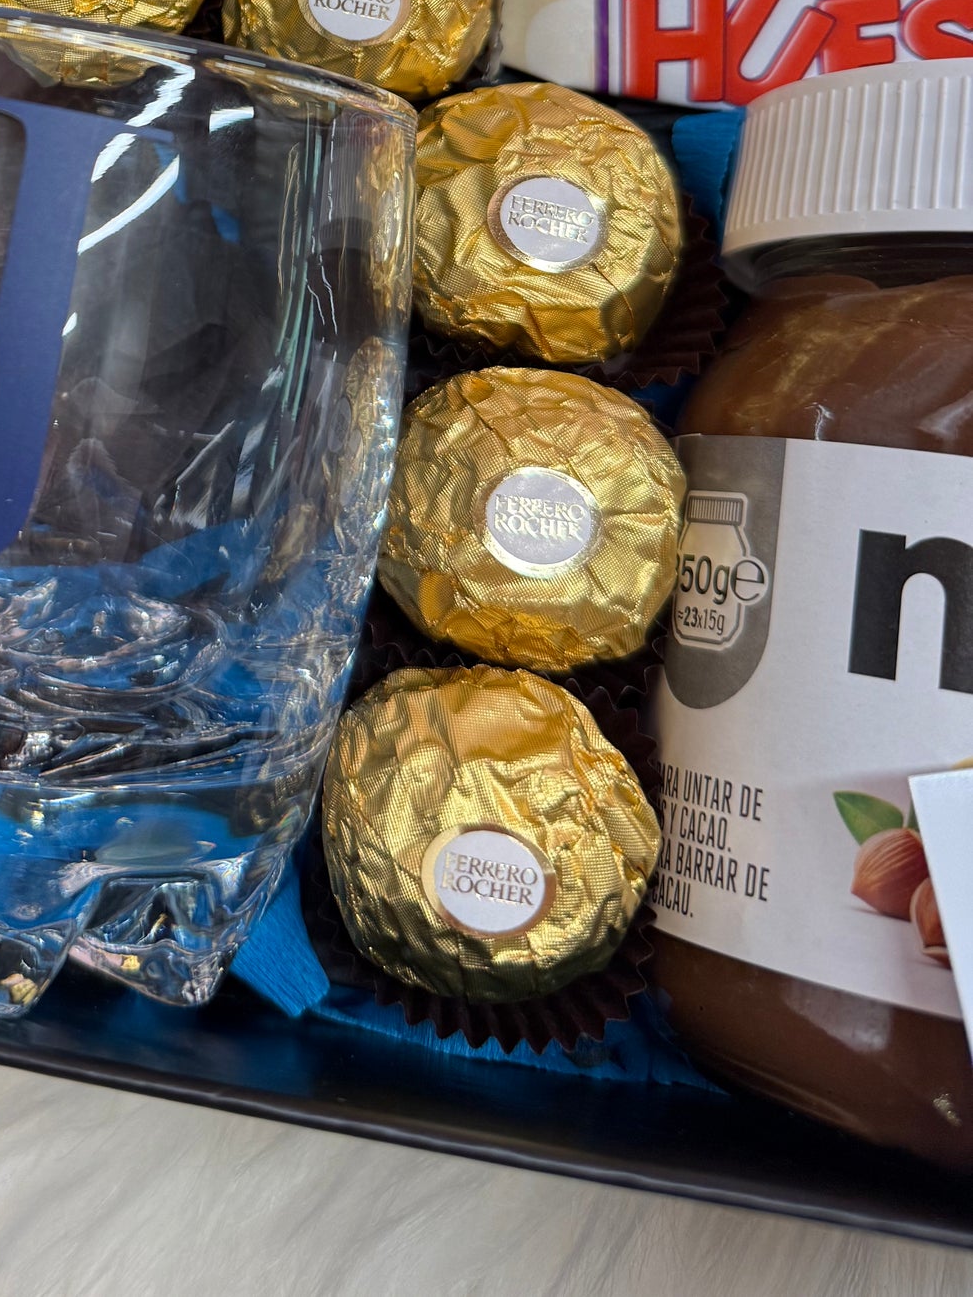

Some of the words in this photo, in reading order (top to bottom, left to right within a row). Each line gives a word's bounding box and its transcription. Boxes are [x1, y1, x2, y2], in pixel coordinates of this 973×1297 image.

[507, 211, 588, 244] ROCHER
[510, 195, 594, 227] FERRERO
[495, 494, 585, 521] FERRERO
[494, 512, 583, 541] ROCHER
[683, 769, 733, 814] UNTAR
[739, 784, 764, 821] DE
[669, 803, 678, 834] Y
[680, 806, 731, 853] CACAO.
[445, 852, 538, 886] FERRERO
[676, 842, 738, 893] BARRAR
[745, 863, 770, 902] DE
[441, 871, 533, 906] ROCHER
